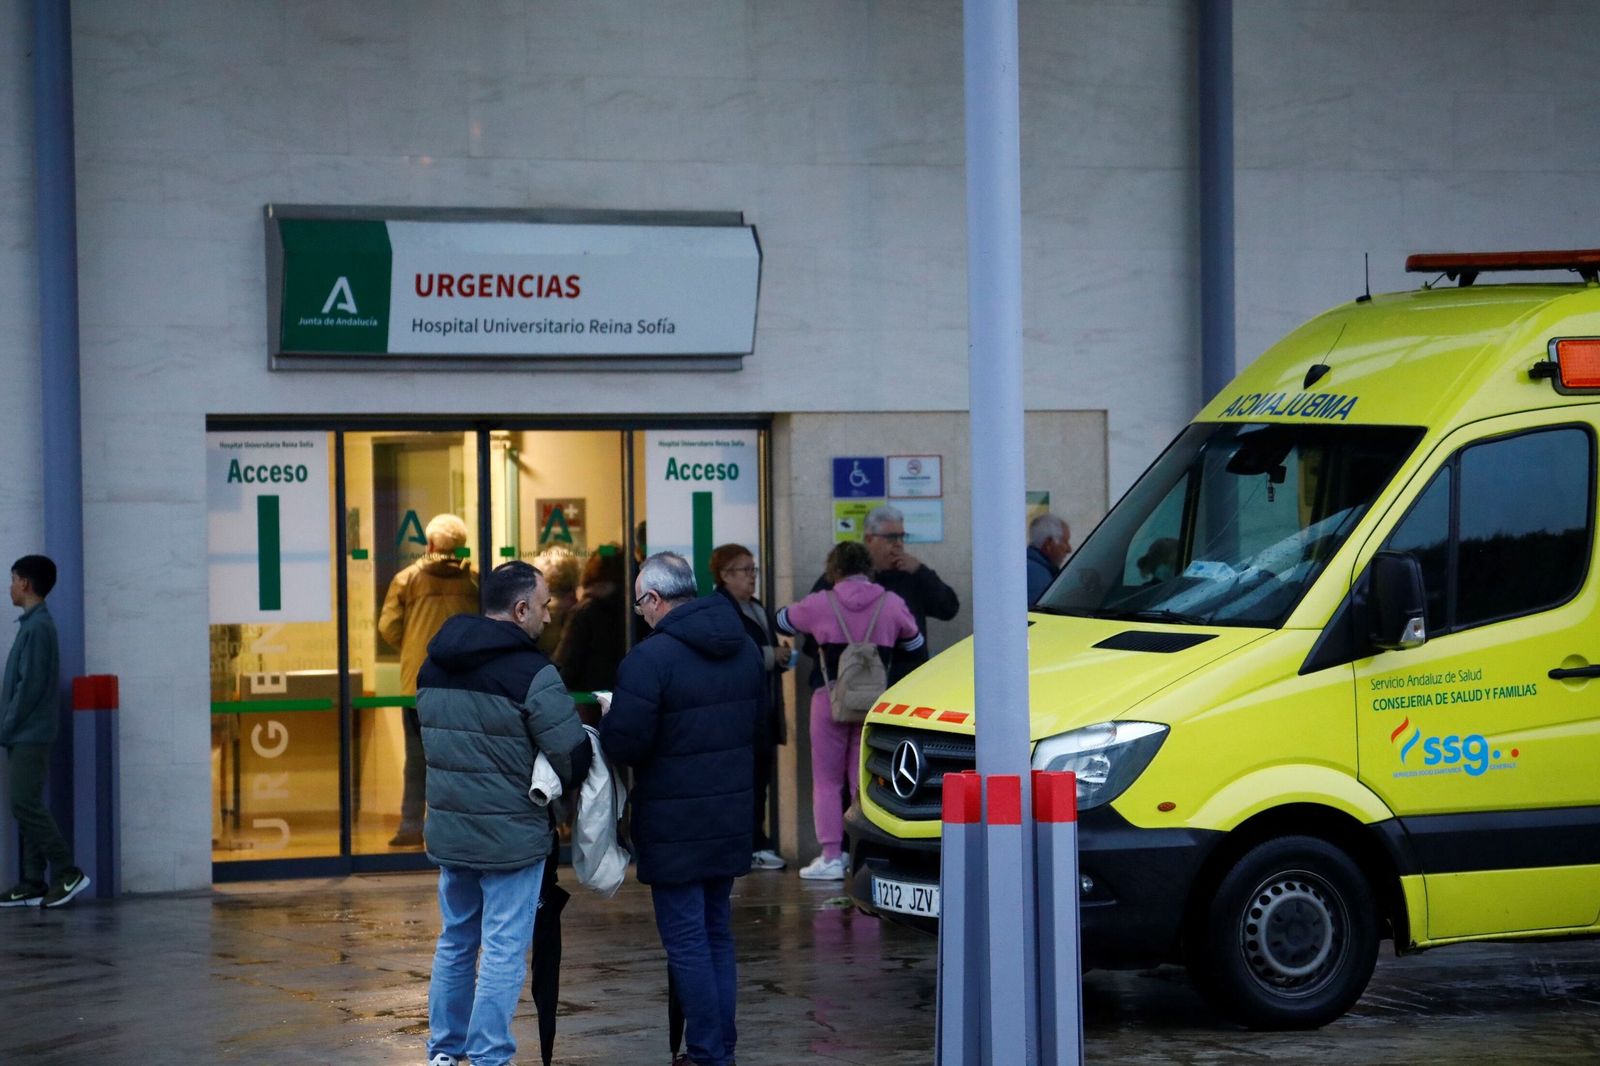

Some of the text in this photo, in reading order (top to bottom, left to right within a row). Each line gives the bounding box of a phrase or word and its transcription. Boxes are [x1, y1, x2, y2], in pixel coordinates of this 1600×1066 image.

[415, 273, 581, 299] URGENCIAS
[298, 316, 378, 327] Junta de Andalucía
[411, 317, 676, 336] Hospital Universitario Reina Sofía
[227, 458, 308, 484] Acceso
[665, 456, 739, 481] Acceso
[1371, 668, 1482, 690] Servicio Andaluz de Salud
[1372, 683, 1537, 711] CONSEJERIA DE SALUD Y FAMILIAS
[878, 882, 933, 912] 1212 JZV
